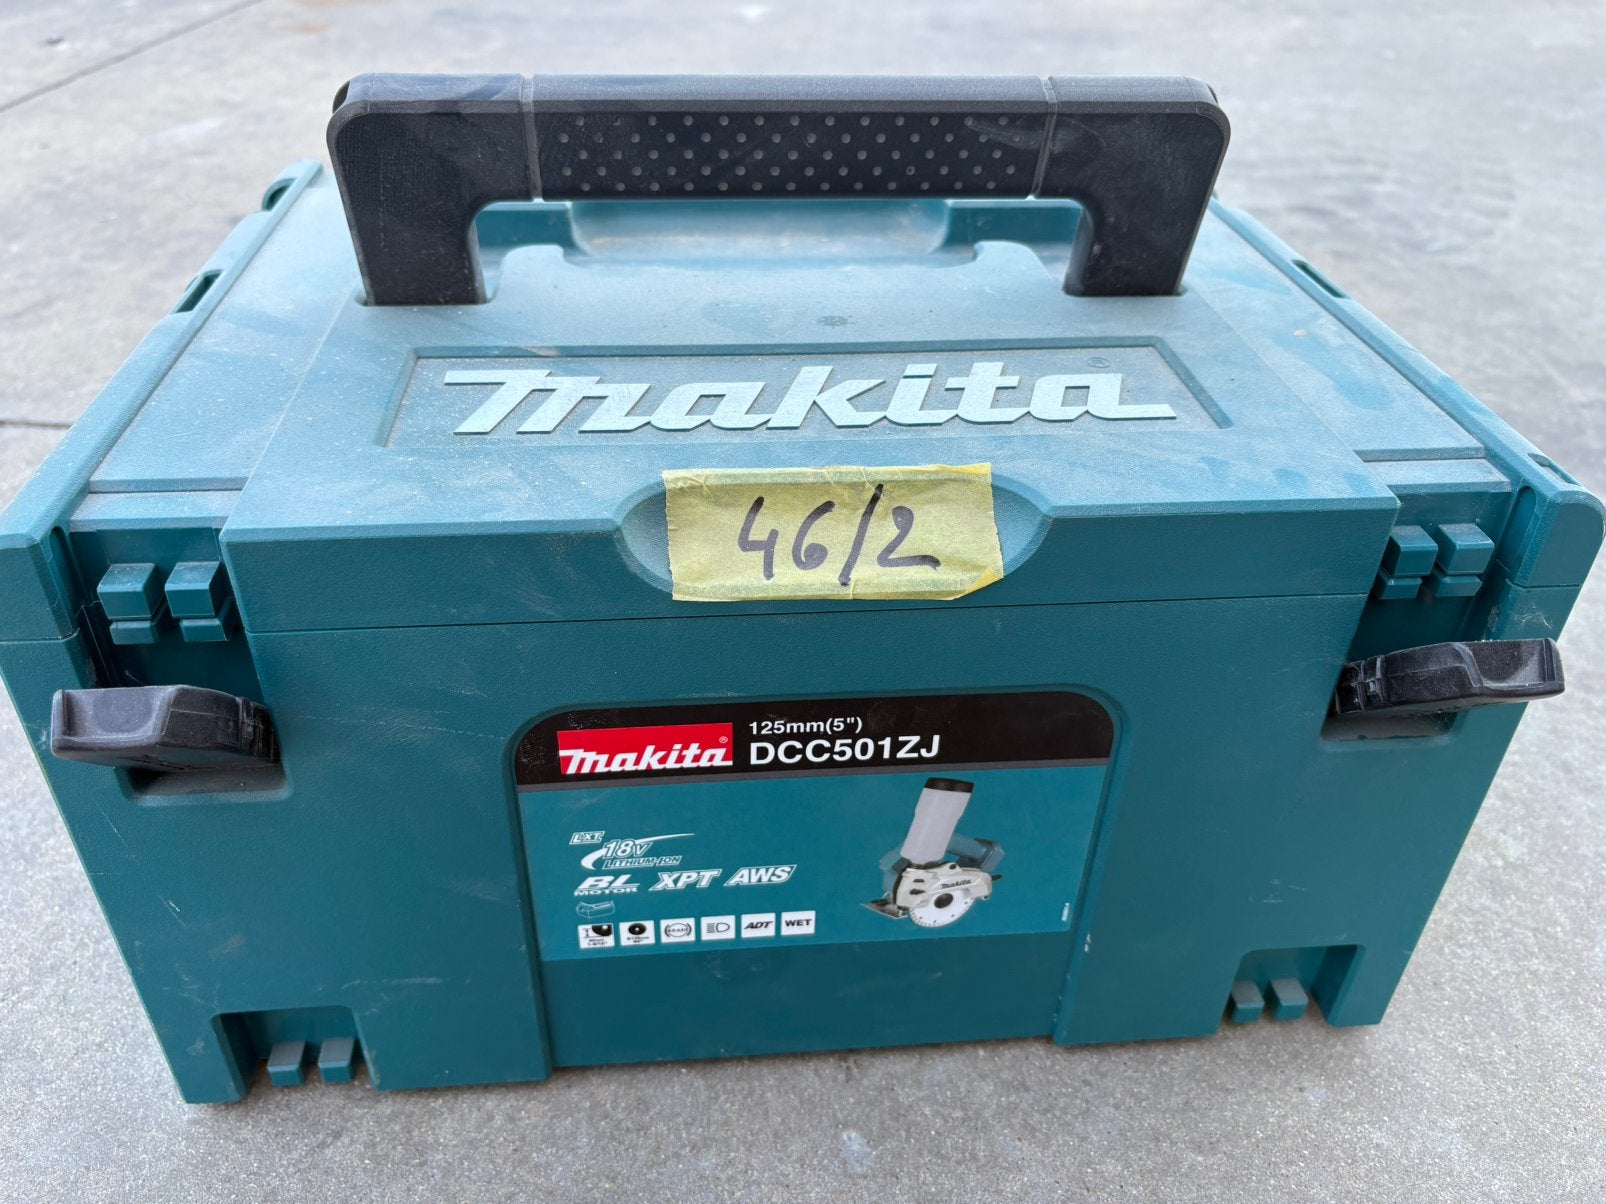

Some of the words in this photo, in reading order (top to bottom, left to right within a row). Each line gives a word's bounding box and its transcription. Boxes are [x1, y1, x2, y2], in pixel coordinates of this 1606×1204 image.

[444, 361, 1177, 435] makita
[738, 483, 941, 587] 46/2
[749, 717, 862, 735] 125mm(5")
[558, 743, 734, 775] makita
[750, 735, 941, 766] DCC501ZJ
[577, 874, 639, 890] BL
[649, 868, 722, 891] XPT
[724, 864, 797, 887] AWS
[940, 878, 972, 889] makita
[574, 887, 638, 896] MOTOR
[744, 920, 773, 930] ADT
[785, 918, 812, 928] WET
